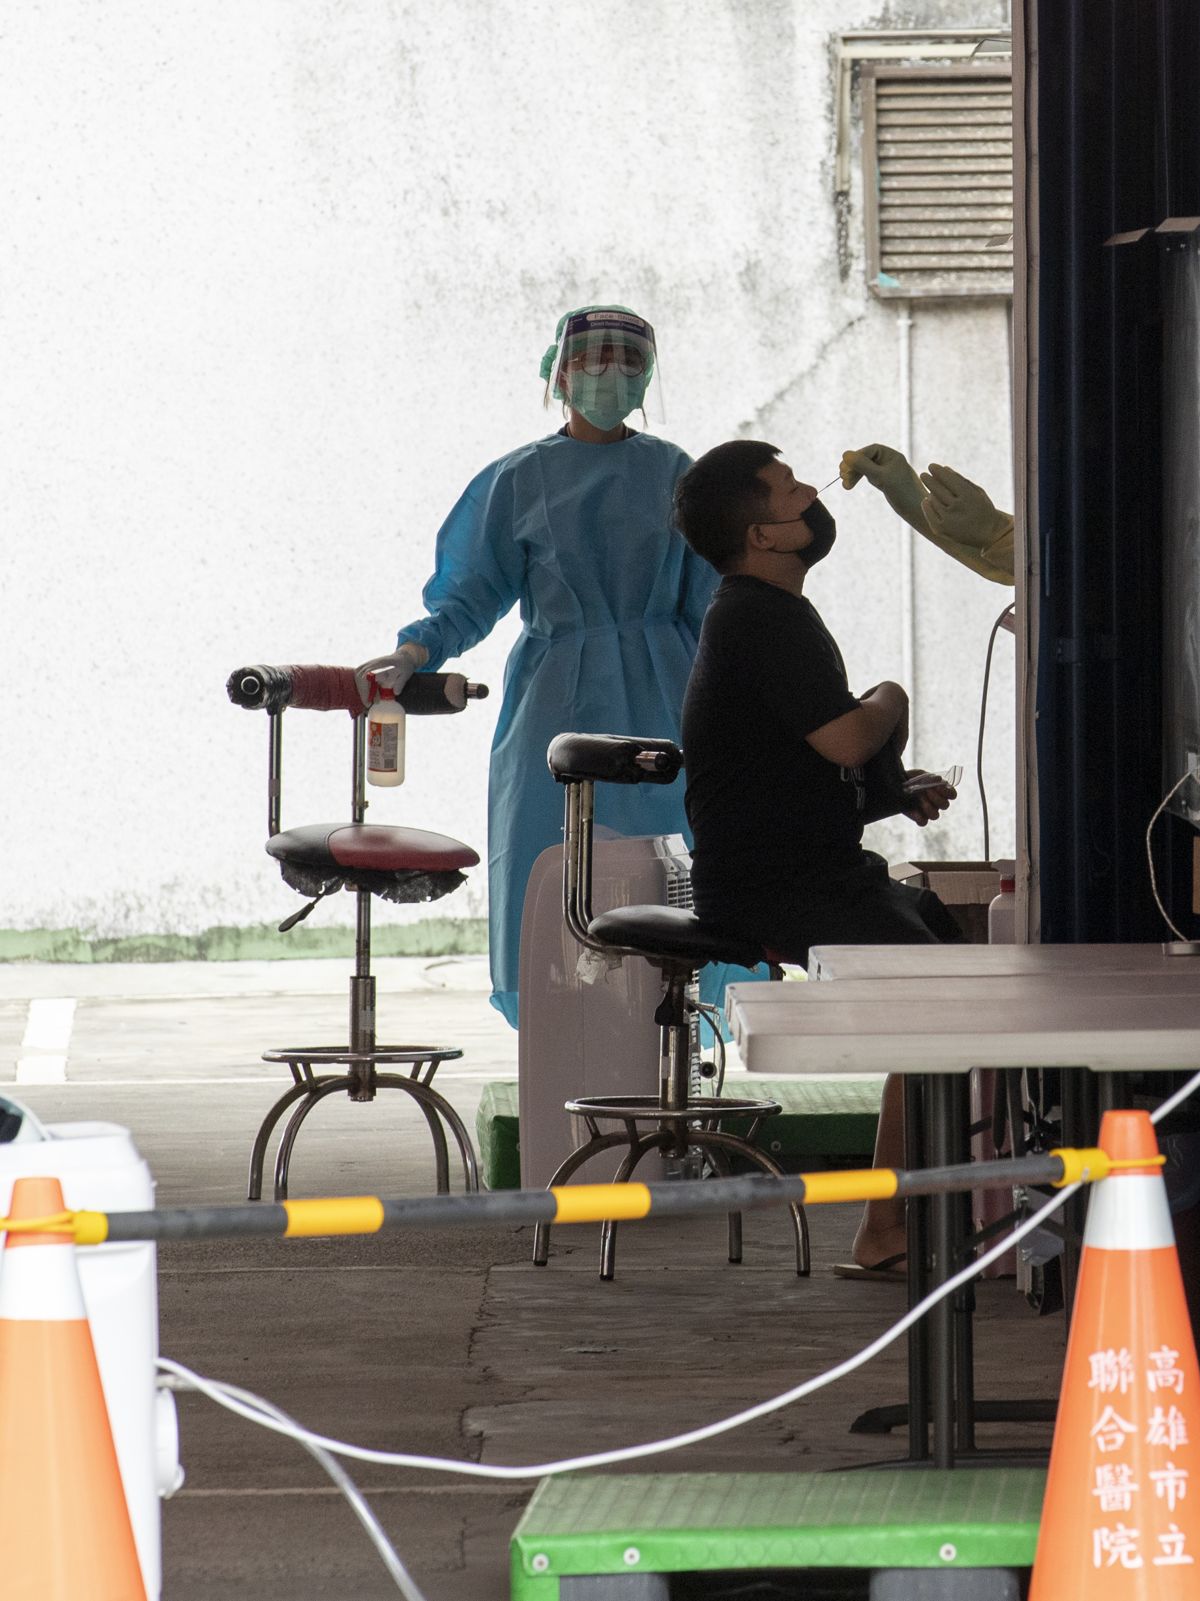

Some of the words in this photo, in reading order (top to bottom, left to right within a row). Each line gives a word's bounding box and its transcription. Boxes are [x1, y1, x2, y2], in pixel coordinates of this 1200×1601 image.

[1088, 1347, 1144, 1569] 聯合醫院
[1145, 1345, 1194, 1566] 高雄市立
